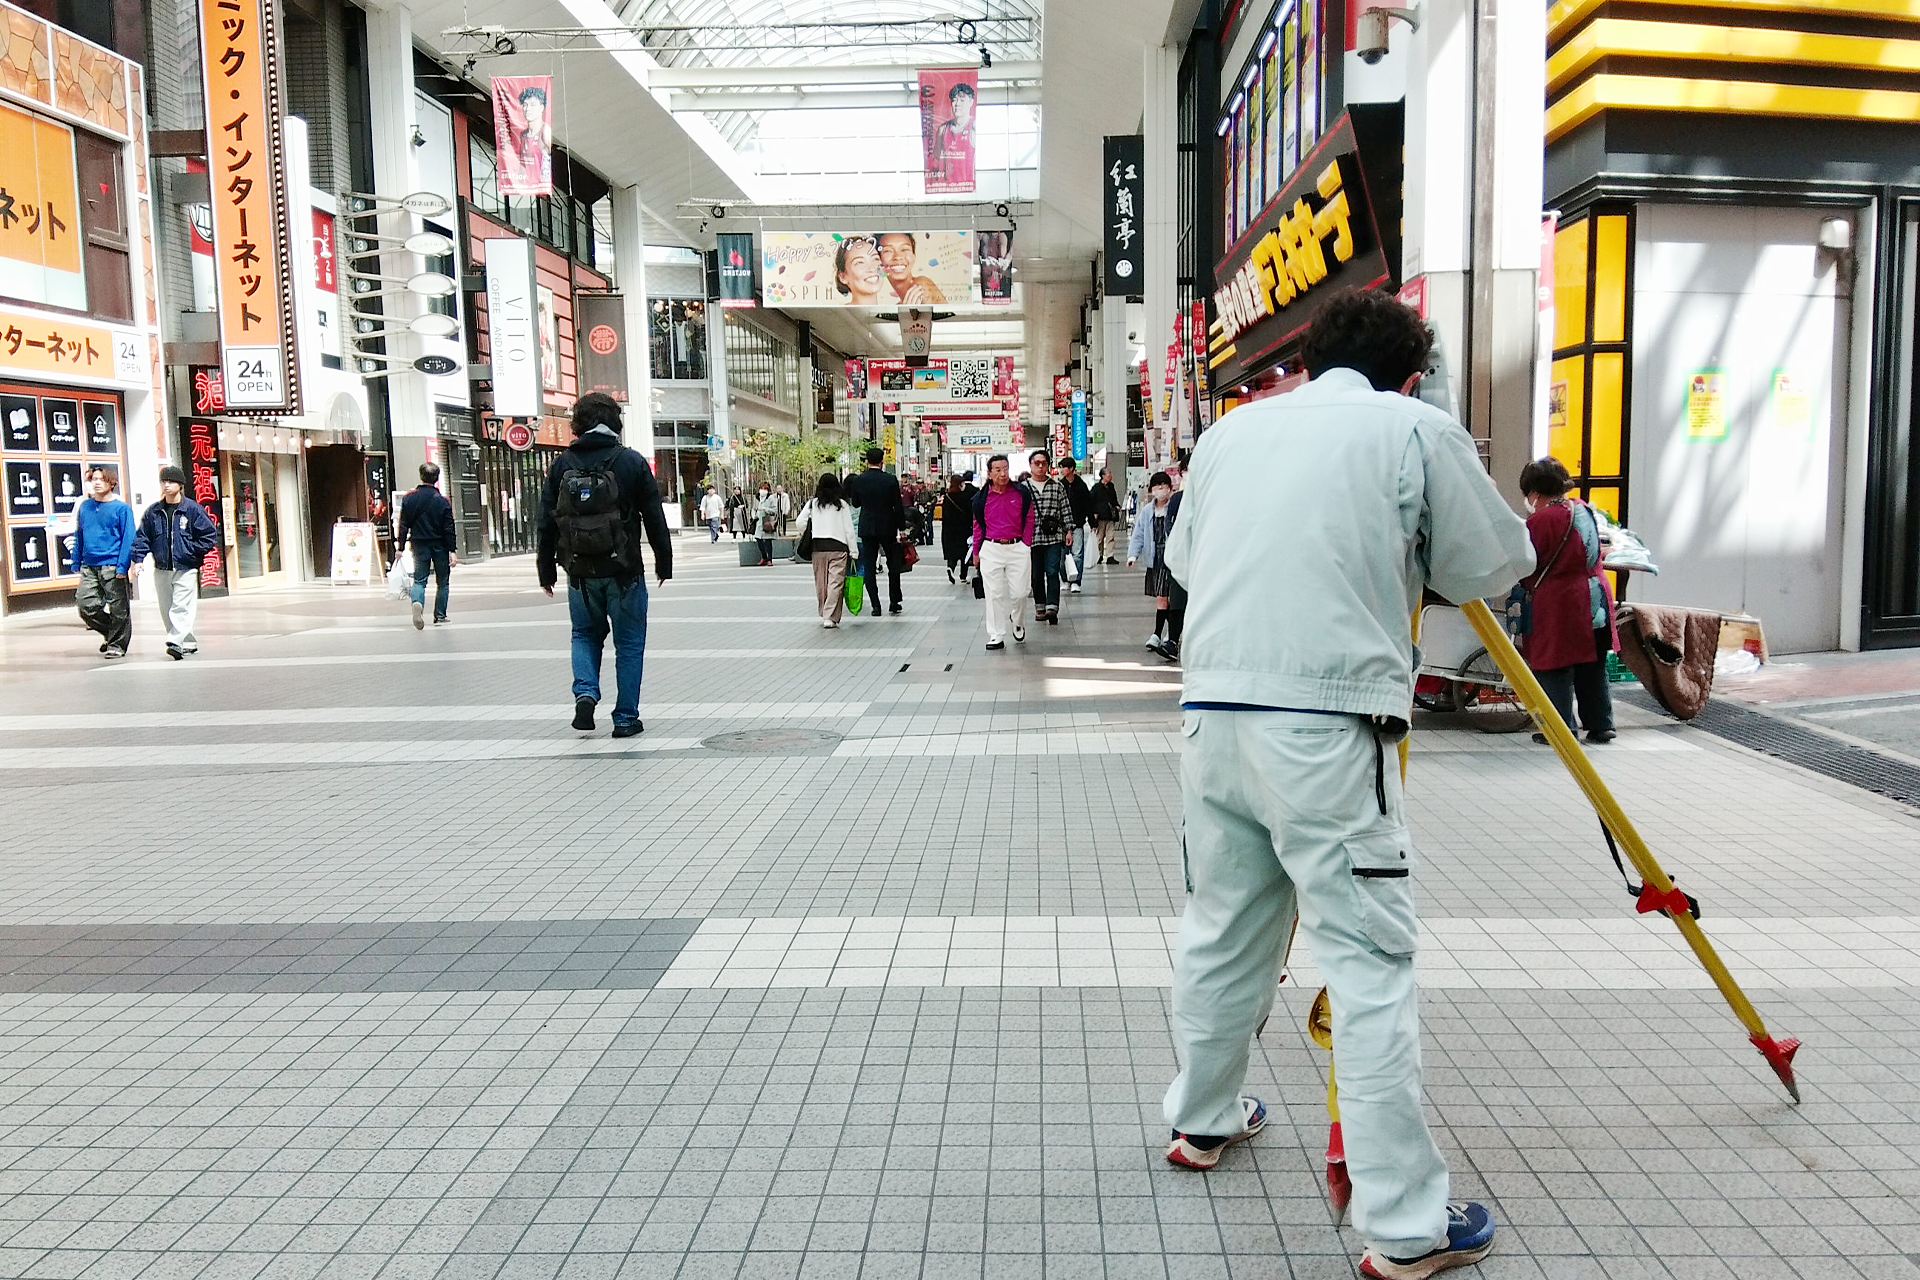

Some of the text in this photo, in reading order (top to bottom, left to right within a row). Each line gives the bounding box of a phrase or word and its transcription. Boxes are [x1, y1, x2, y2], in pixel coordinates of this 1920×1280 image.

[354, 202, 361, 210] 4
[1109, 159, 1138, 250] 紅蘭亭
[357, 240, 365, 251] 3
[360, 281, 367, 291] 2
[790, 285, 833, 300] SPTM
[490, 277, 500, 314] COFFEE
[494, 326, 503, 347] AND
[0, 325, 100, 366] ターネット
[120, 362, 142, 375] OPEN
[237, 360, 273, 379] 24h
[365, 361, 373, 371] B
[496, 350, 505, 377] MORE
[237, 382, 274, 393] OPEN
